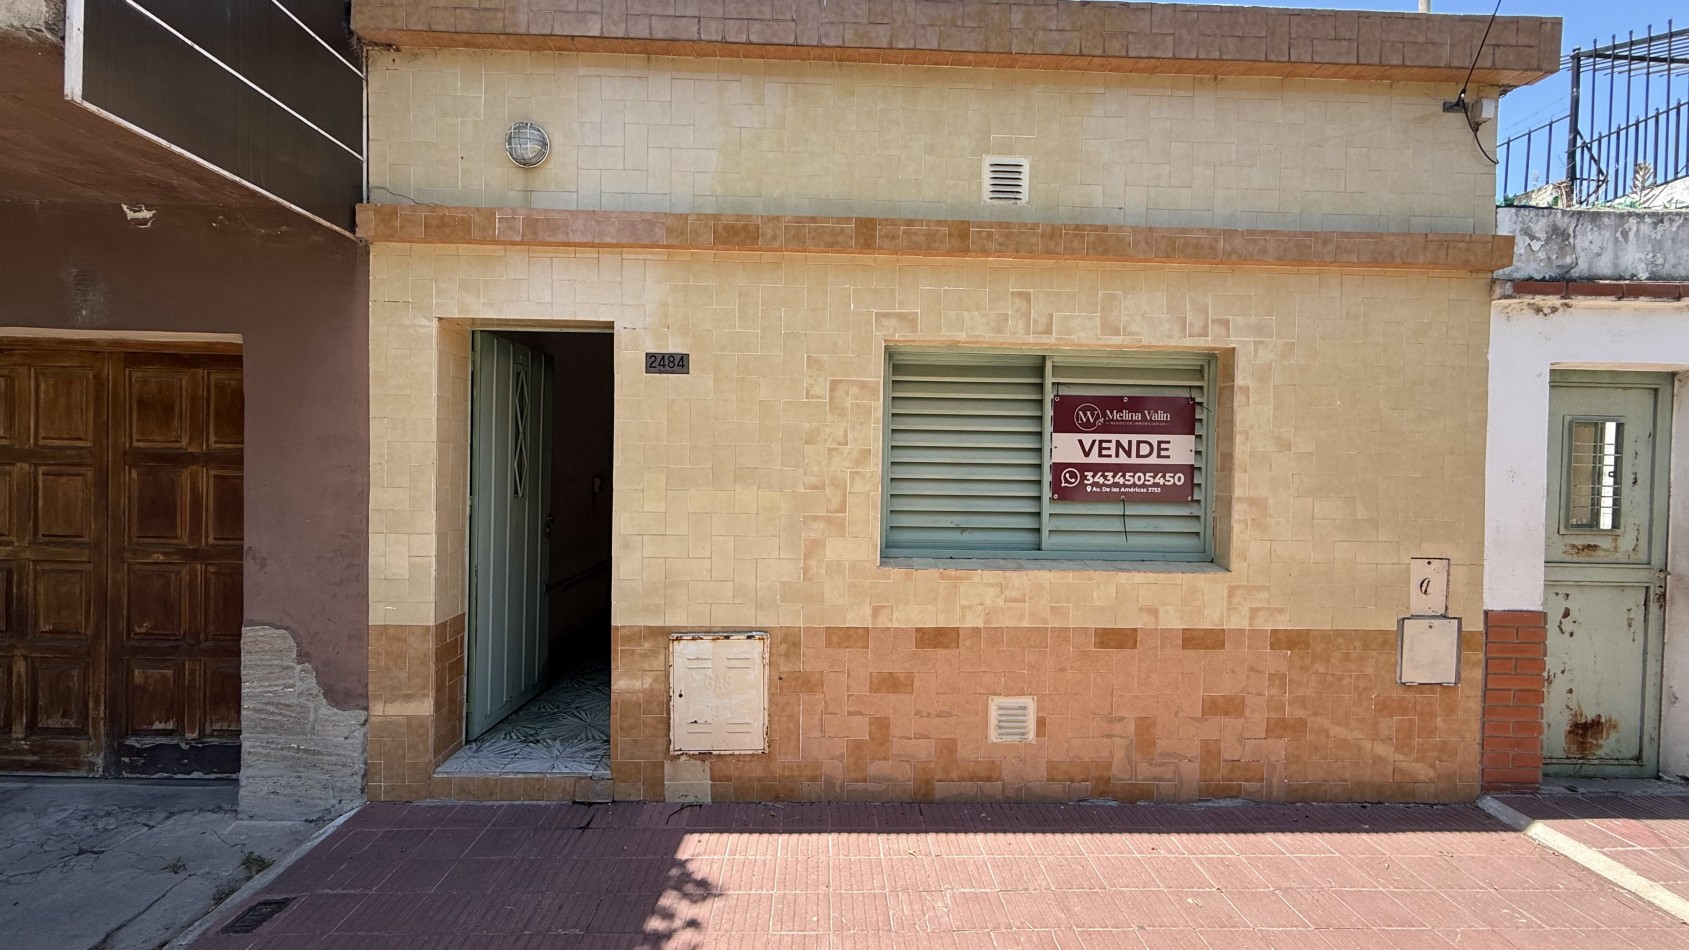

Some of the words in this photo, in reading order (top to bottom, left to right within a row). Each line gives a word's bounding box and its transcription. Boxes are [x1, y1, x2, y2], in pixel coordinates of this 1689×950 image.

[649, 355, 685, 368] 2484
[1105, 409, 1142, 420] Melina
[1144, 410, 1170, 421] Valin
[1077, 439, 1171, 459] VENDE
[1083, 471, 1185, 486] 3434505450
[704, 674, 733, 691] GAS
